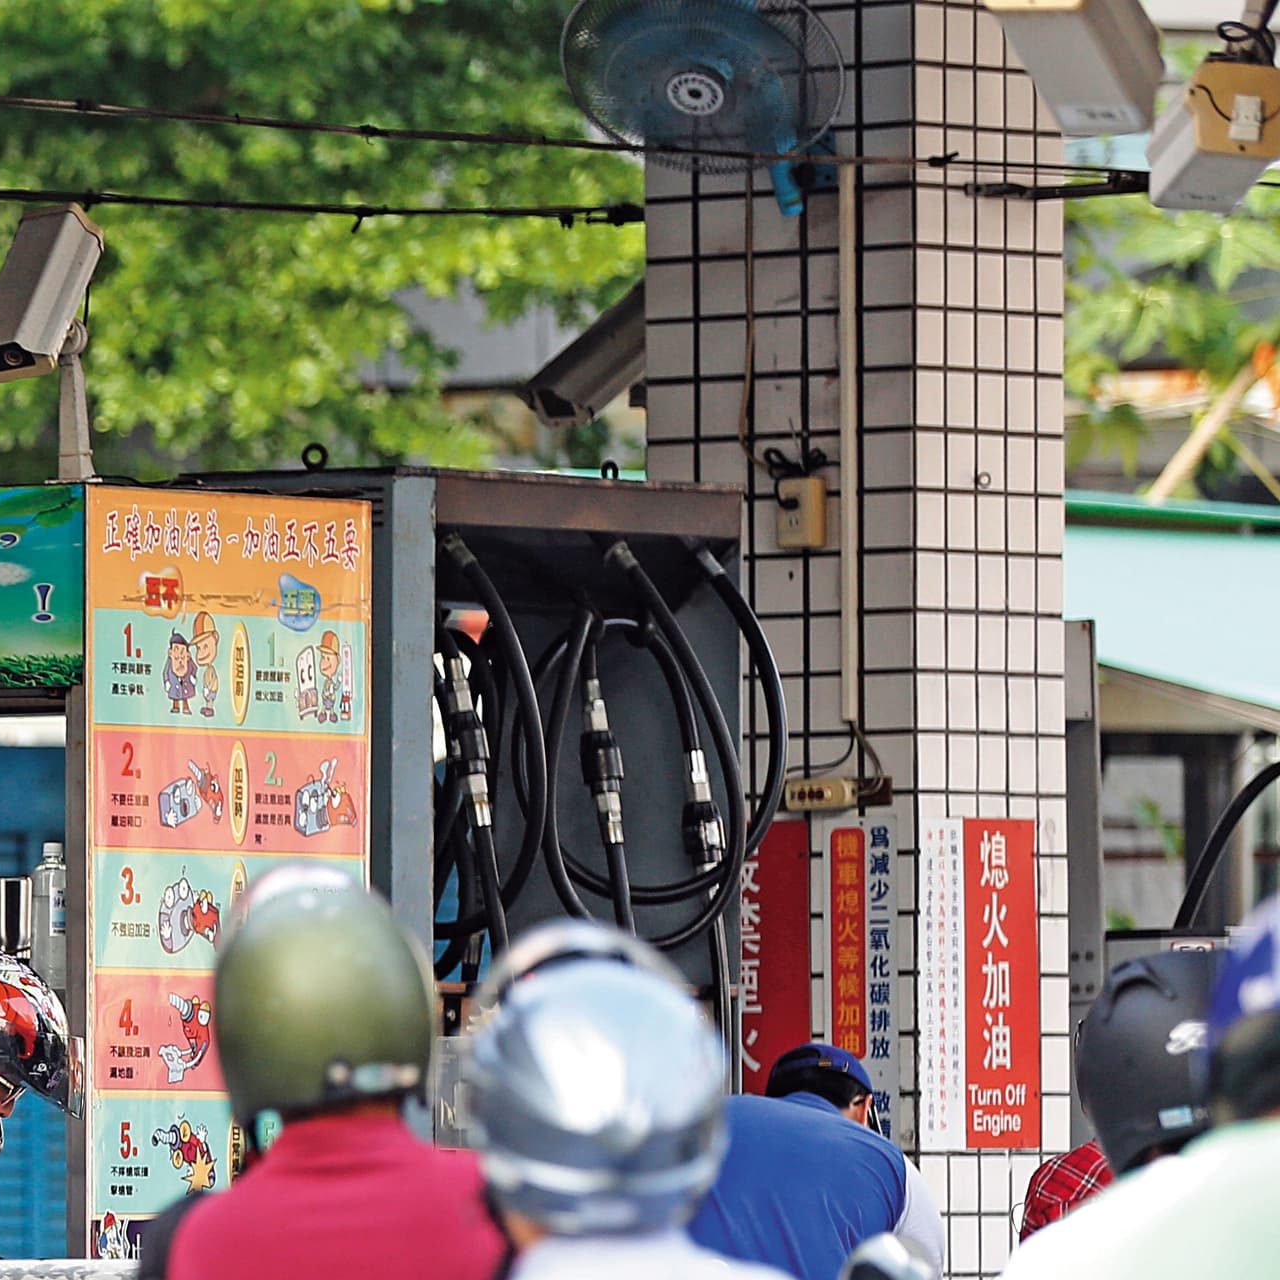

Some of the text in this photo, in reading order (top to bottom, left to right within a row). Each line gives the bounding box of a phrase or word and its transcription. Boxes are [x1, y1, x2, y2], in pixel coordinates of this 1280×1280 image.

[979, 830, 1012, 1071] 熄火加油
[968, 1083, 1027, 1106] Turn Off
[972, 1110, 1022, 1137] Engine
